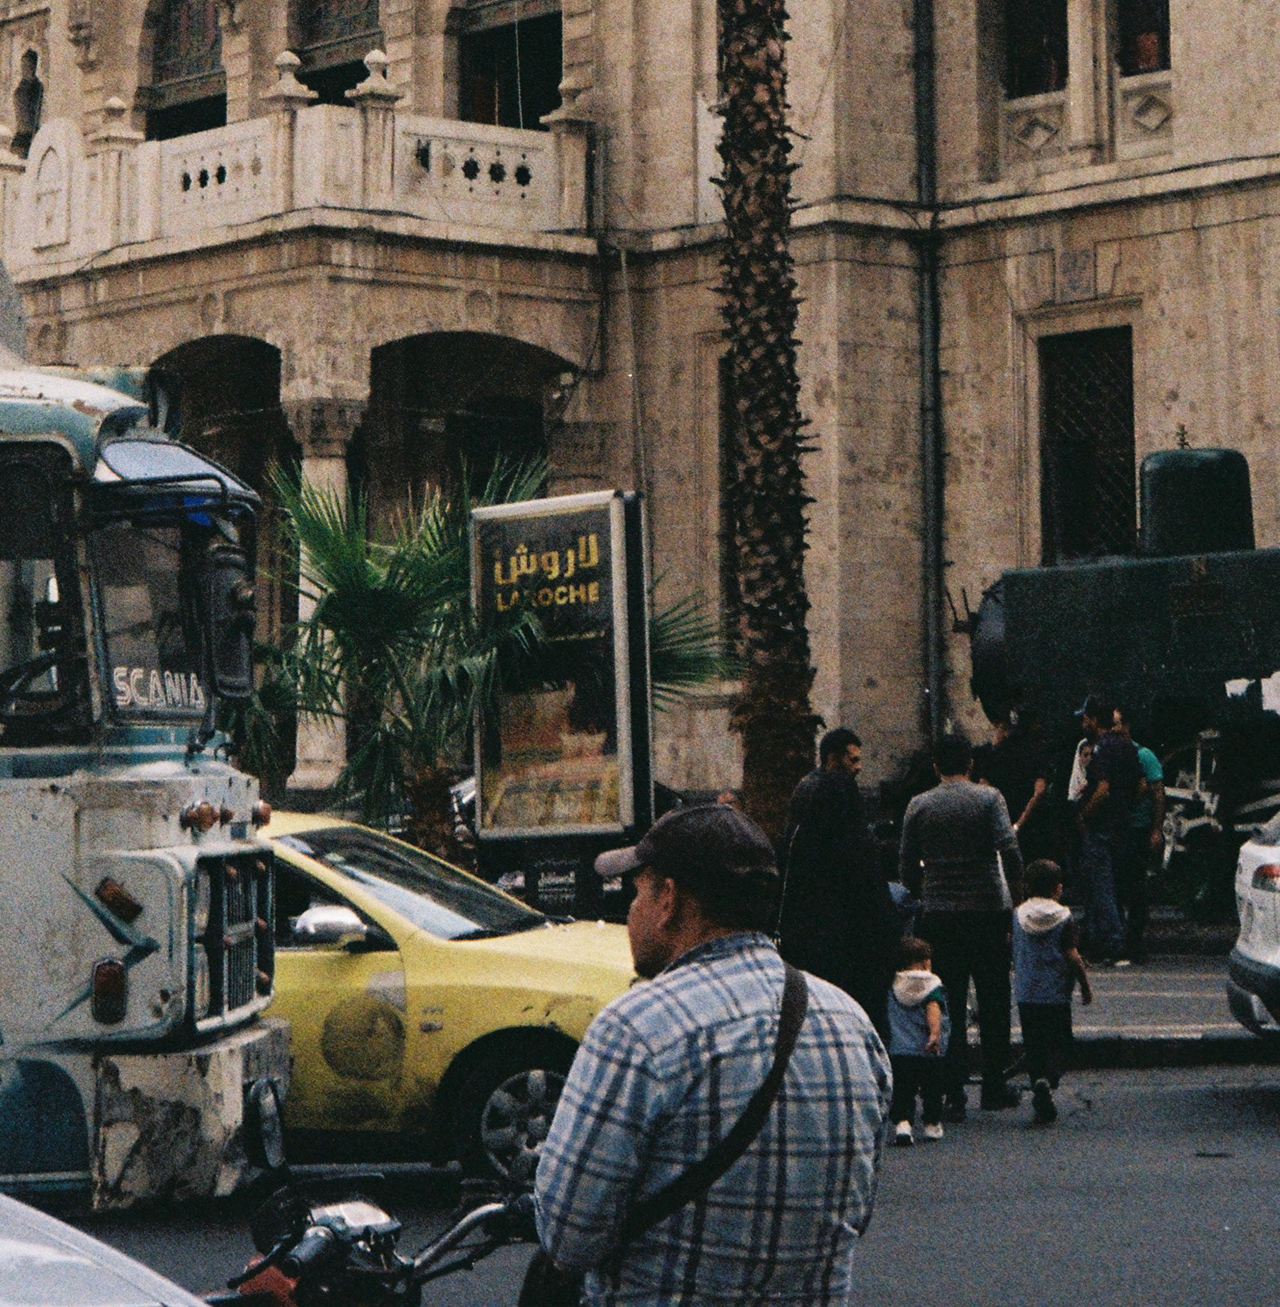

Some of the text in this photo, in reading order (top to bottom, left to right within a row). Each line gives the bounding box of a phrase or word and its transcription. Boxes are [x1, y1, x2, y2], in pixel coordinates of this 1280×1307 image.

[494, 533, 599, 585] لاروش
[497, 581, 600, 612] LAOCHE
[113, 665, 207, 711] SCANIA
